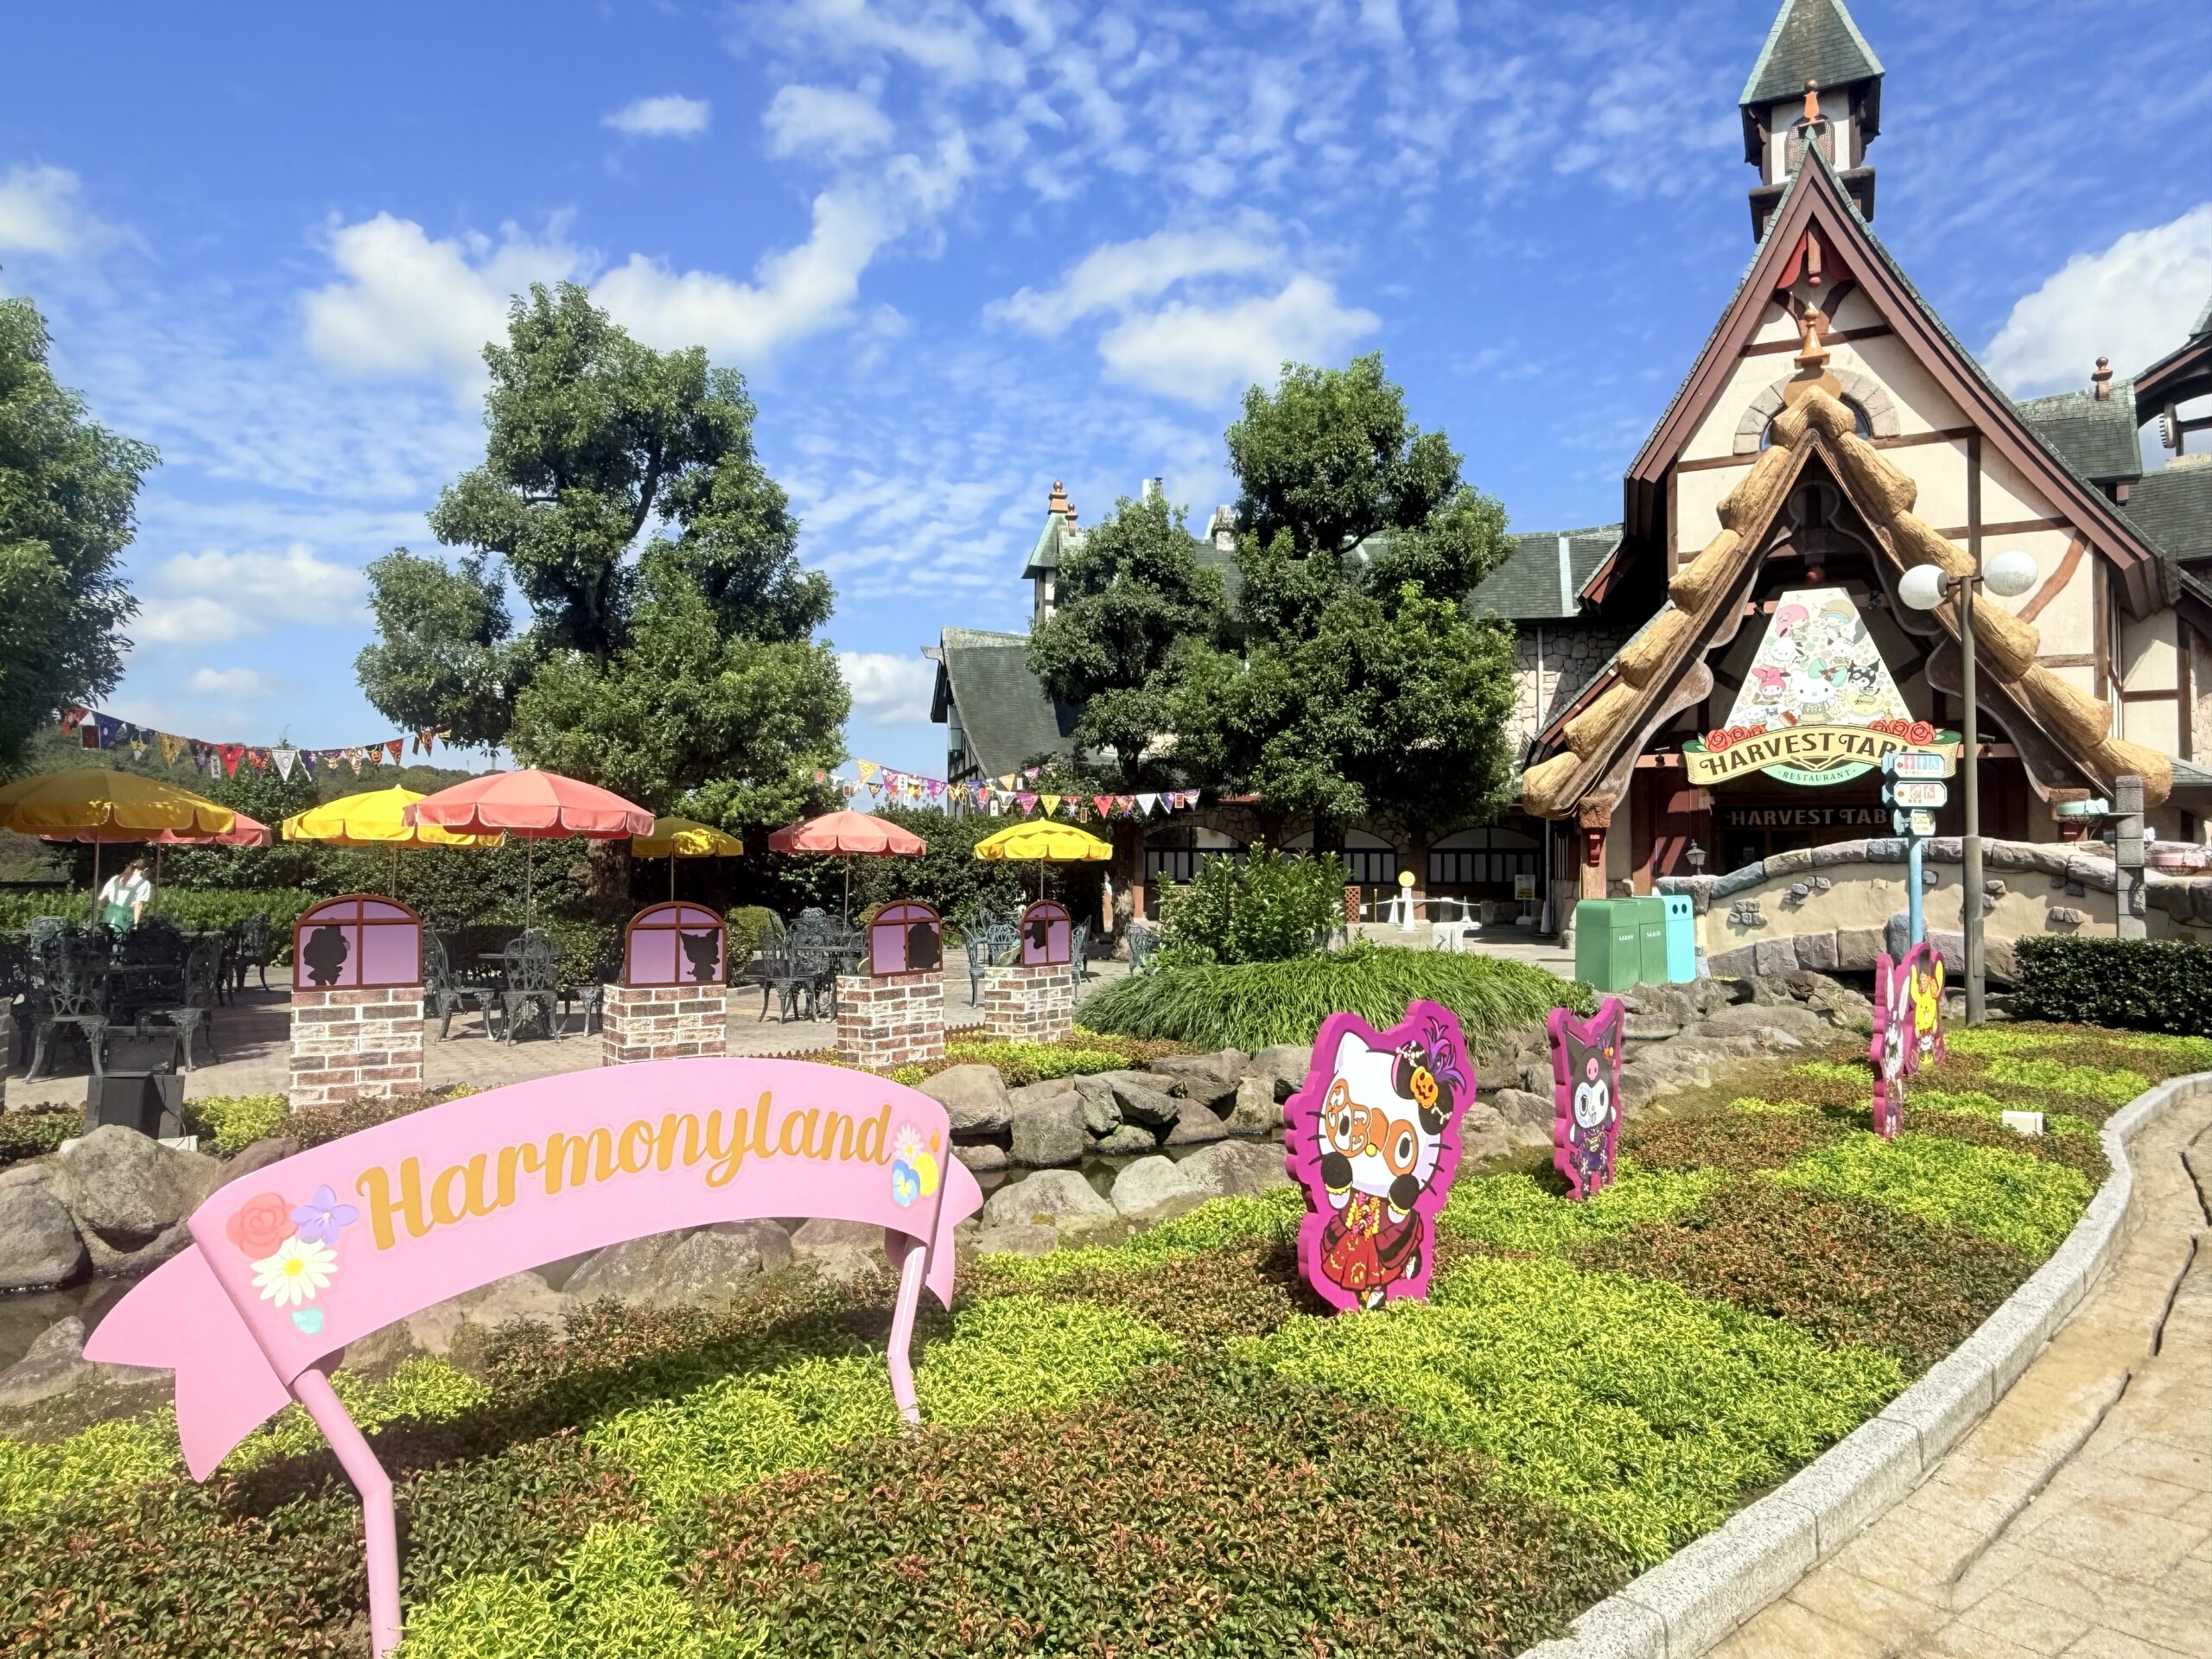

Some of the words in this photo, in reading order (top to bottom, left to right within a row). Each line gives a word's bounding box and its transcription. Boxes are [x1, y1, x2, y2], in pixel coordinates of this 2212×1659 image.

[1700, 733, 1835, 776] HARVEST
[1839, 734, 1930, 759] TAB
[1783, 769, 1851, 782] RESTAURANT
[1725, 809, 1834, 826] HARVEST
[1840, 808, 1889, 824] TAB
[356, 1090, 893, 1250] Harmonyland
